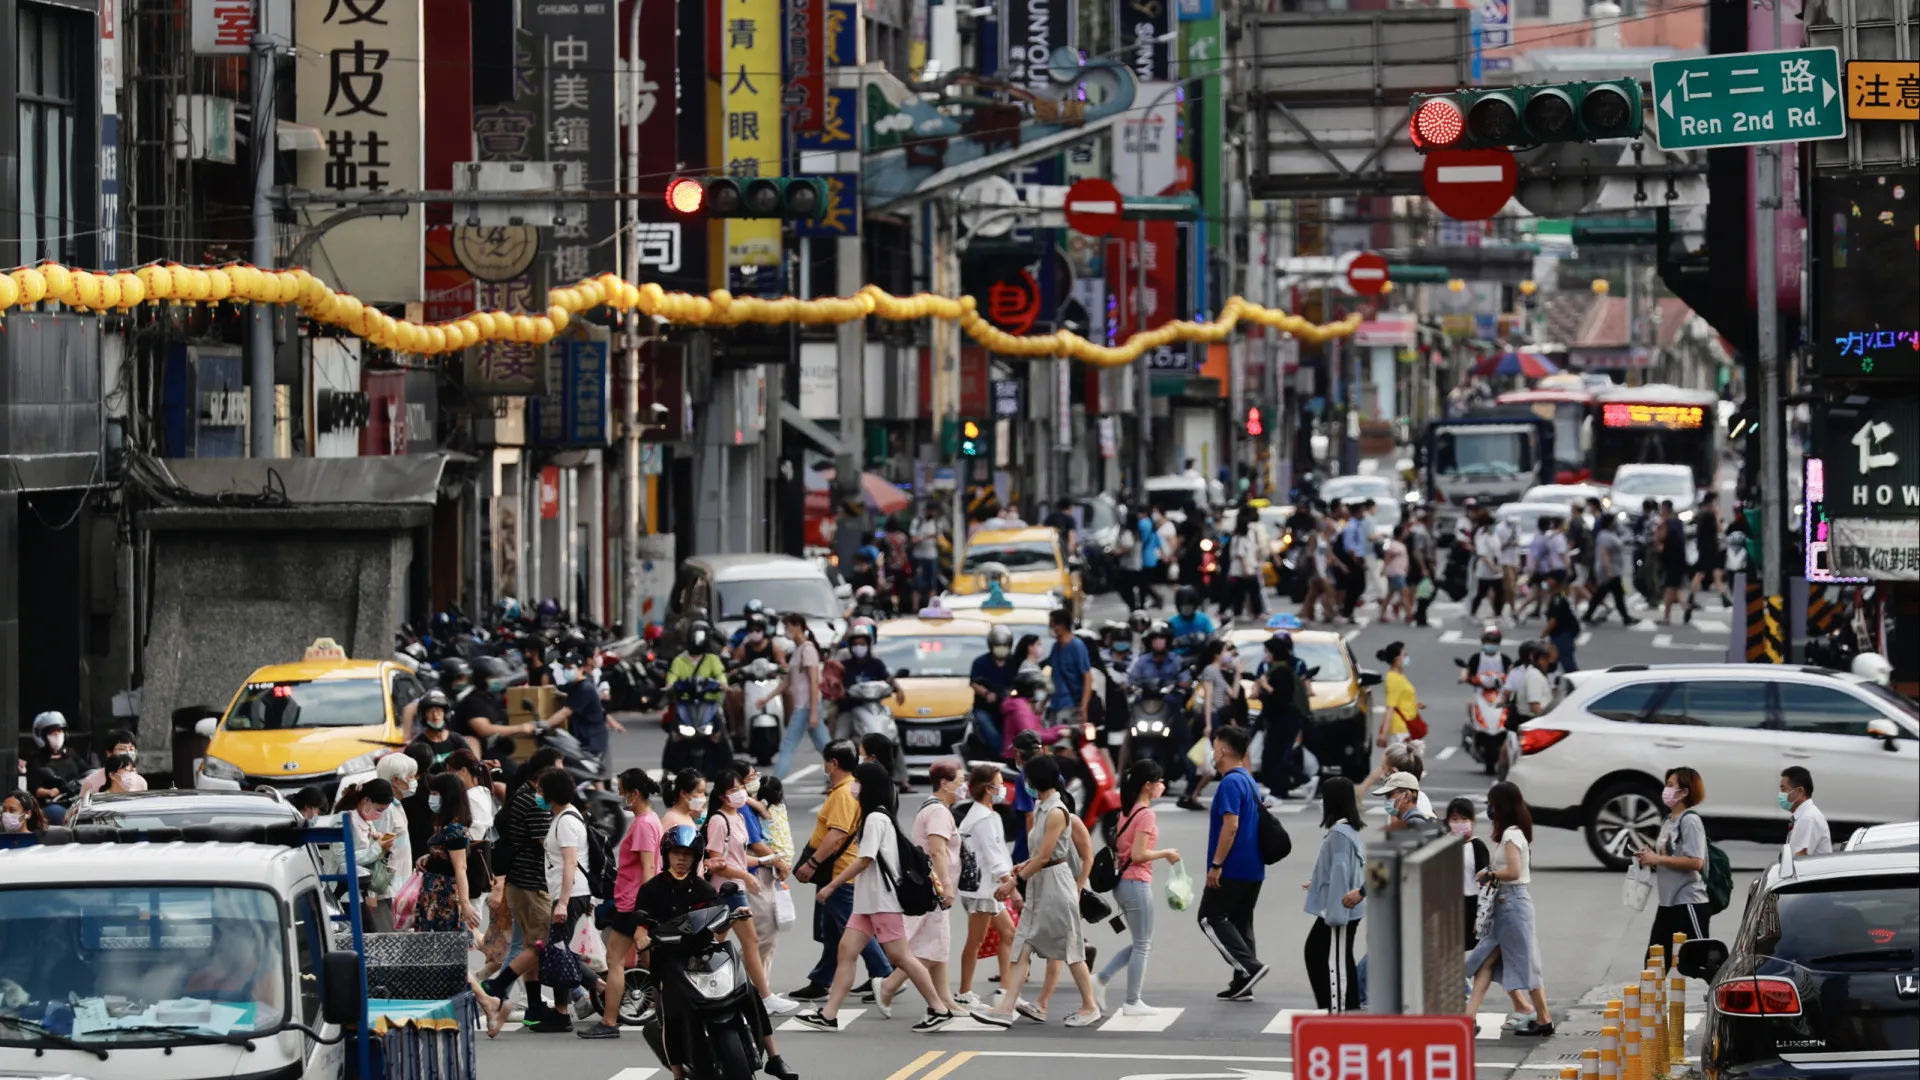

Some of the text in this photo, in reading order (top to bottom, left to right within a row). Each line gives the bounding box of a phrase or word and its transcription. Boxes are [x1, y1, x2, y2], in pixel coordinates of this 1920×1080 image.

[537, 4, 605, 15] CHUNG MEI
[1677, 58, 1816, 102] 仁二路
[1855, 73, 1919, 109] 注意
[1680, 107, 1821, 136] Ren 2nd Rd.
[552, 35, 590, 281] 中美鐘銀樓
[1851, 420, 1900, 475] 仁
[1308, 1043, 1458, 1080] 8月11日
[1776, 1039, 1826, 1048] LUXGEN
